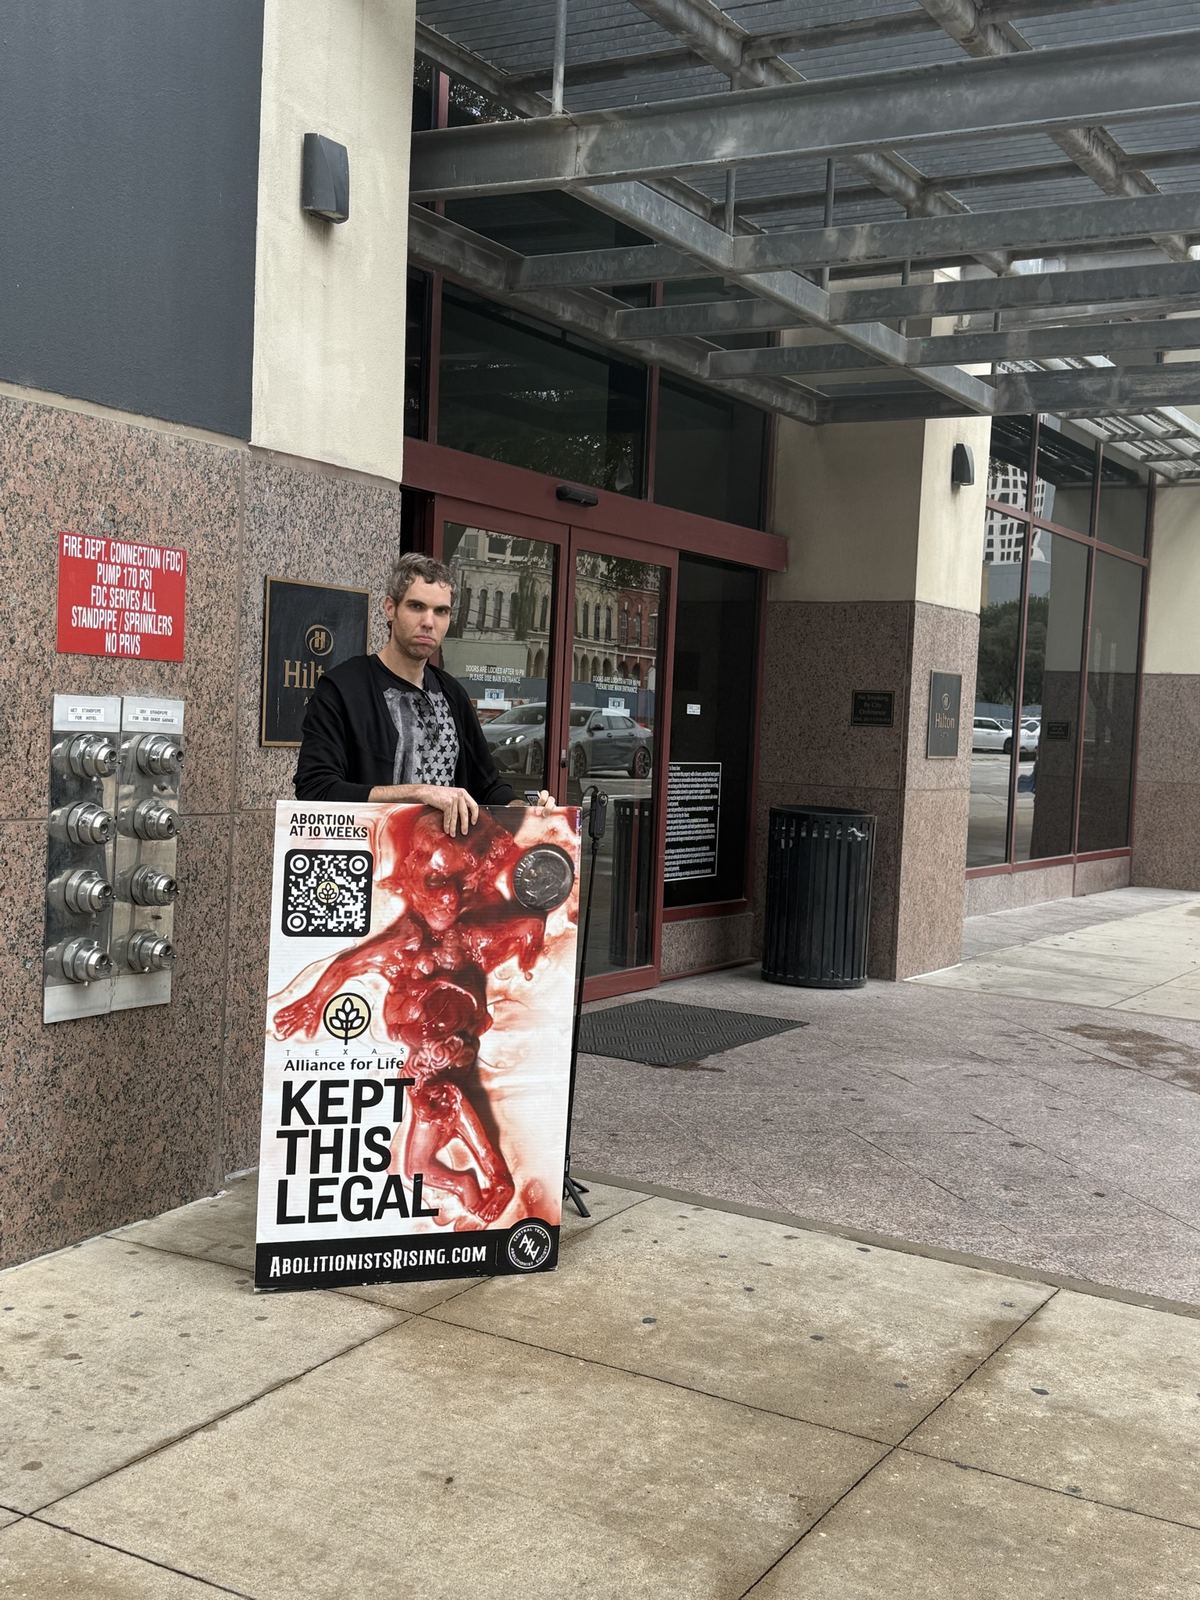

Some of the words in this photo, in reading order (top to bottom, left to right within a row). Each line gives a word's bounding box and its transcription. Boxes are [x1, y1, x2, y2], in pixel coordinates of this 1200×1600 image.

[63, 535, 82, 558] FIRE
[85, 538, 107, 561] DEPT.
[110, 541, 160, 568] CONNECTION
[162, 549, 183, 576] (FDC)
[97, 563, 121, 585] PUMP
[123, 567, 137, 588] 170
[140, 569, 152, 590] PSI
[91, 585, 107, 607] FDC
[109, 587, 140, 611] SERVES
[142, 592, 156, 612] ALL
[71, 605, 117, 630] STANDPIPE
[124, 611, 173, 636] SPRINKLERS
[105, 632, 117, 653] NO
[119, 634, 141, 655] PRVS
[283, 659, 325, 689] Hilt
[465, 664, 479, 673] DOORS
[935, 712, 955, 729] Hilton
[289, 825, 305, 836] AT
[308, 826, 321, 837] 10
[324, 826, 368, 838] WEEKS
[290, 813, 355, 825] ABORTION
[284, 1059, 346, 1071] Alliance
[350, 1058, 373, 1071] for
[377, 1057, 404, 1070] Life
[286, 1048, 405, 1056] TEXAS
[280, 1078, 416, 1126] KEPT
[276, 1126, 392, 1175] THIS
[276, 1173, 440, 1225] LEGAL
